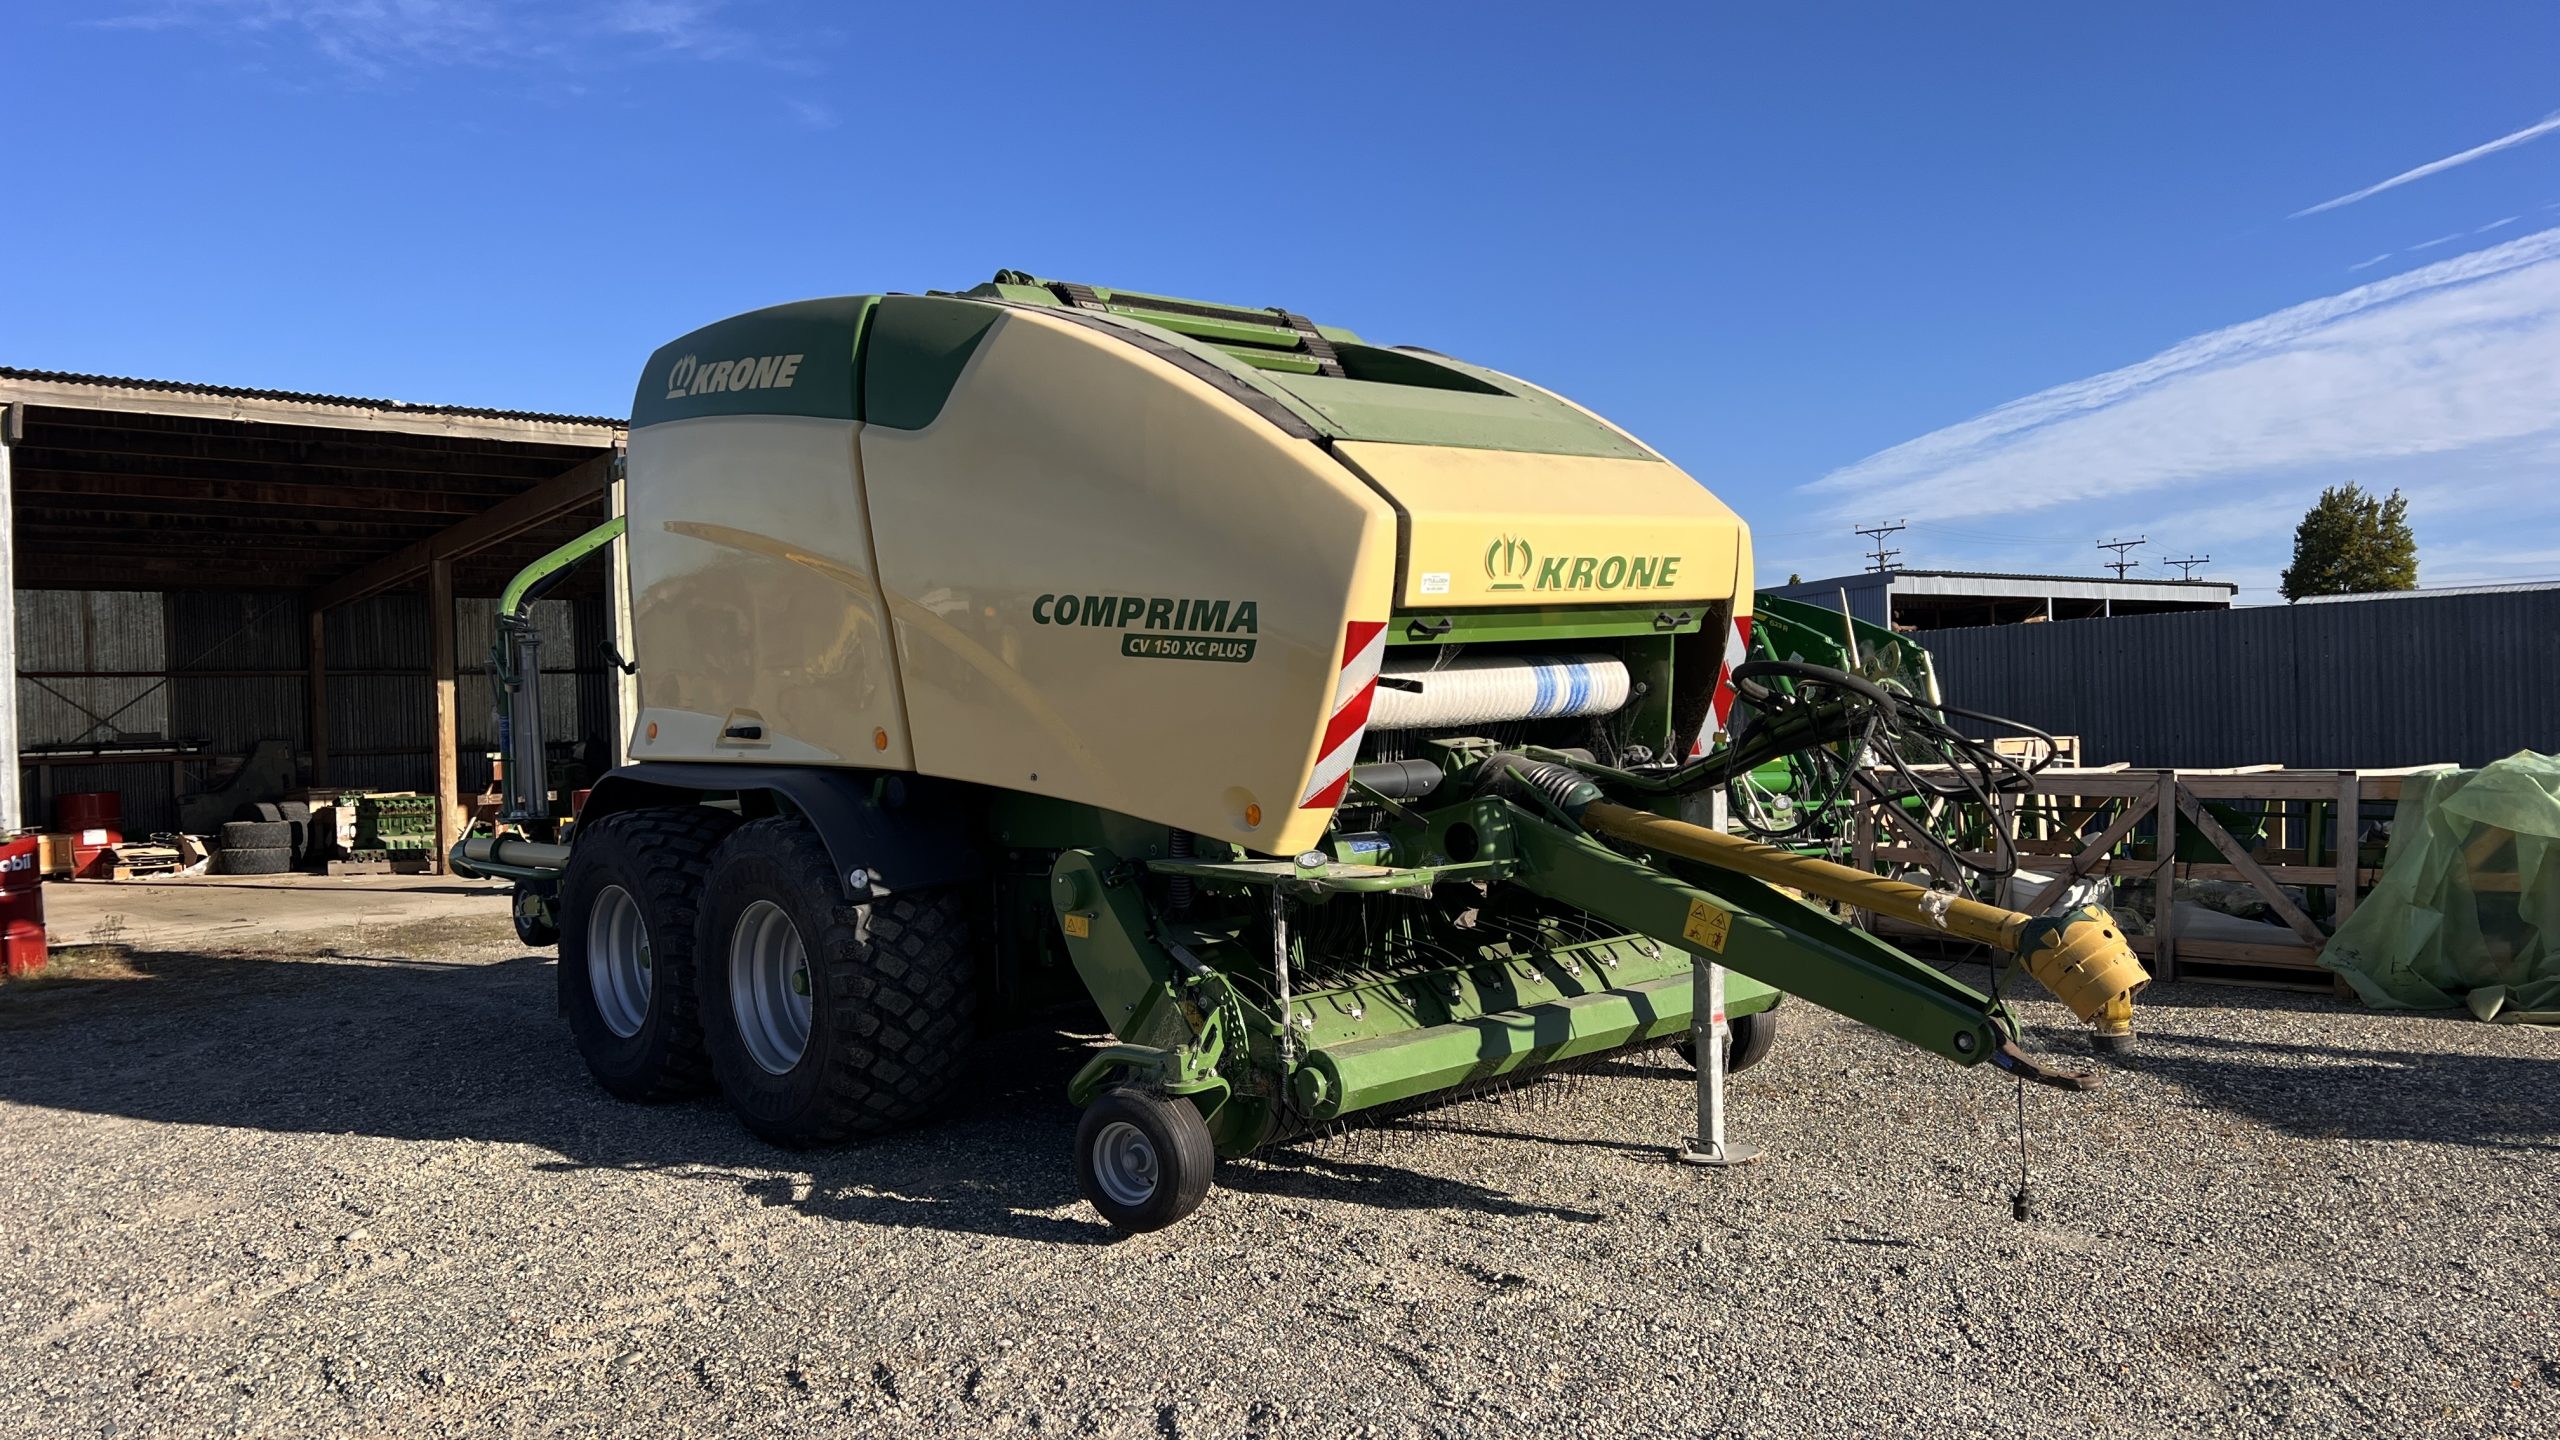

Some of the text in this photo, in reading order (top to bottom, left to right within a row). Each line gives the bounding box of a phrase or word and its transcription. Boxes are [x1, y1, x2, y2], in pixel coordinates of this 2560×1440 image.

[691, 354, 804, 395] KRONE
[1535, 556, 1681, 590] KRONE
[1032, 594, 1259, 634] COMPRIMA
[1129, 638, 1247, 658] CV 150 XC PLUS
